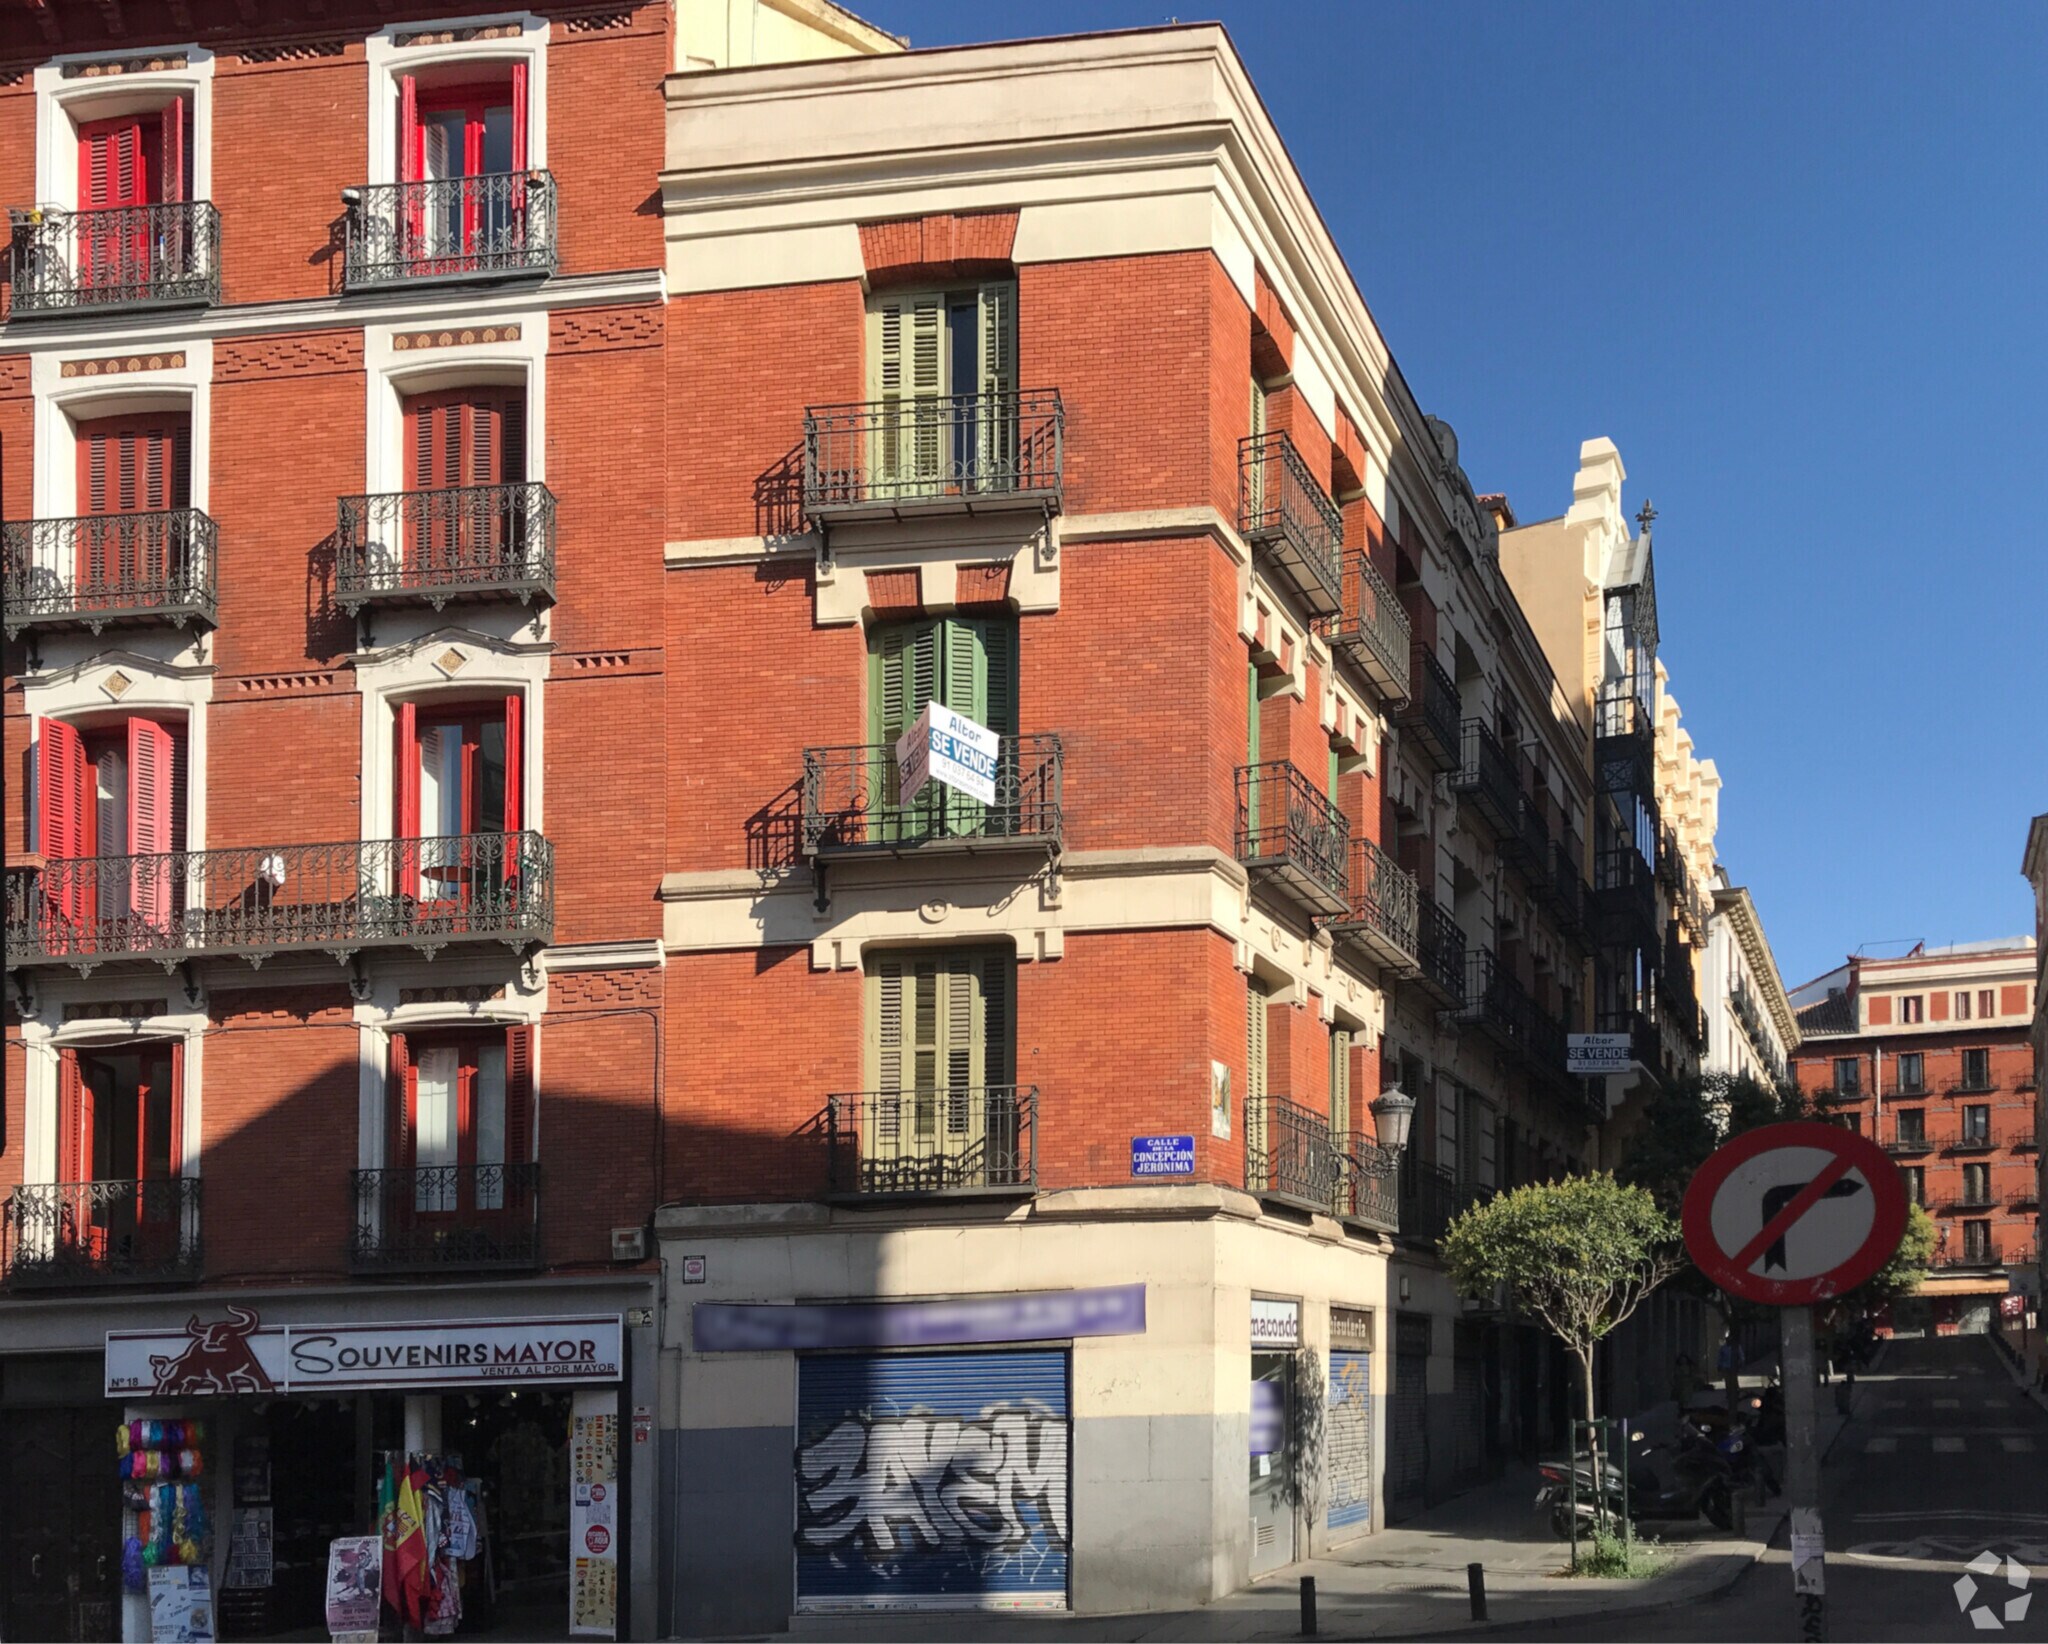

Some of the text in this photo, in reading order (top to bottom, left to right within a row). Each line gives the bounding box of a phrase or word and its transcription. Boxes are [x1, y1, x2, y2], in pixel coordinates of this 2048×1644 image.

[949, 716, 981, 742] Altor
[931, 730, 996, 779] SE VENDE
[1583, 1036, 1614, 1045] Altor
[1569, 1048, 1629, 1059] SE VENDE
[1147, 1138, 1179, 1146] CALLE
[1133, 1149, 1193, 1163] CONCEPCIÓN
[291, 1336, 596, 1374] SOUVENIRS MAYOR
[480, 1363, 616, 1376] VENTA AL POR MAYOR
[126, 1377, 139, 1387] 18
